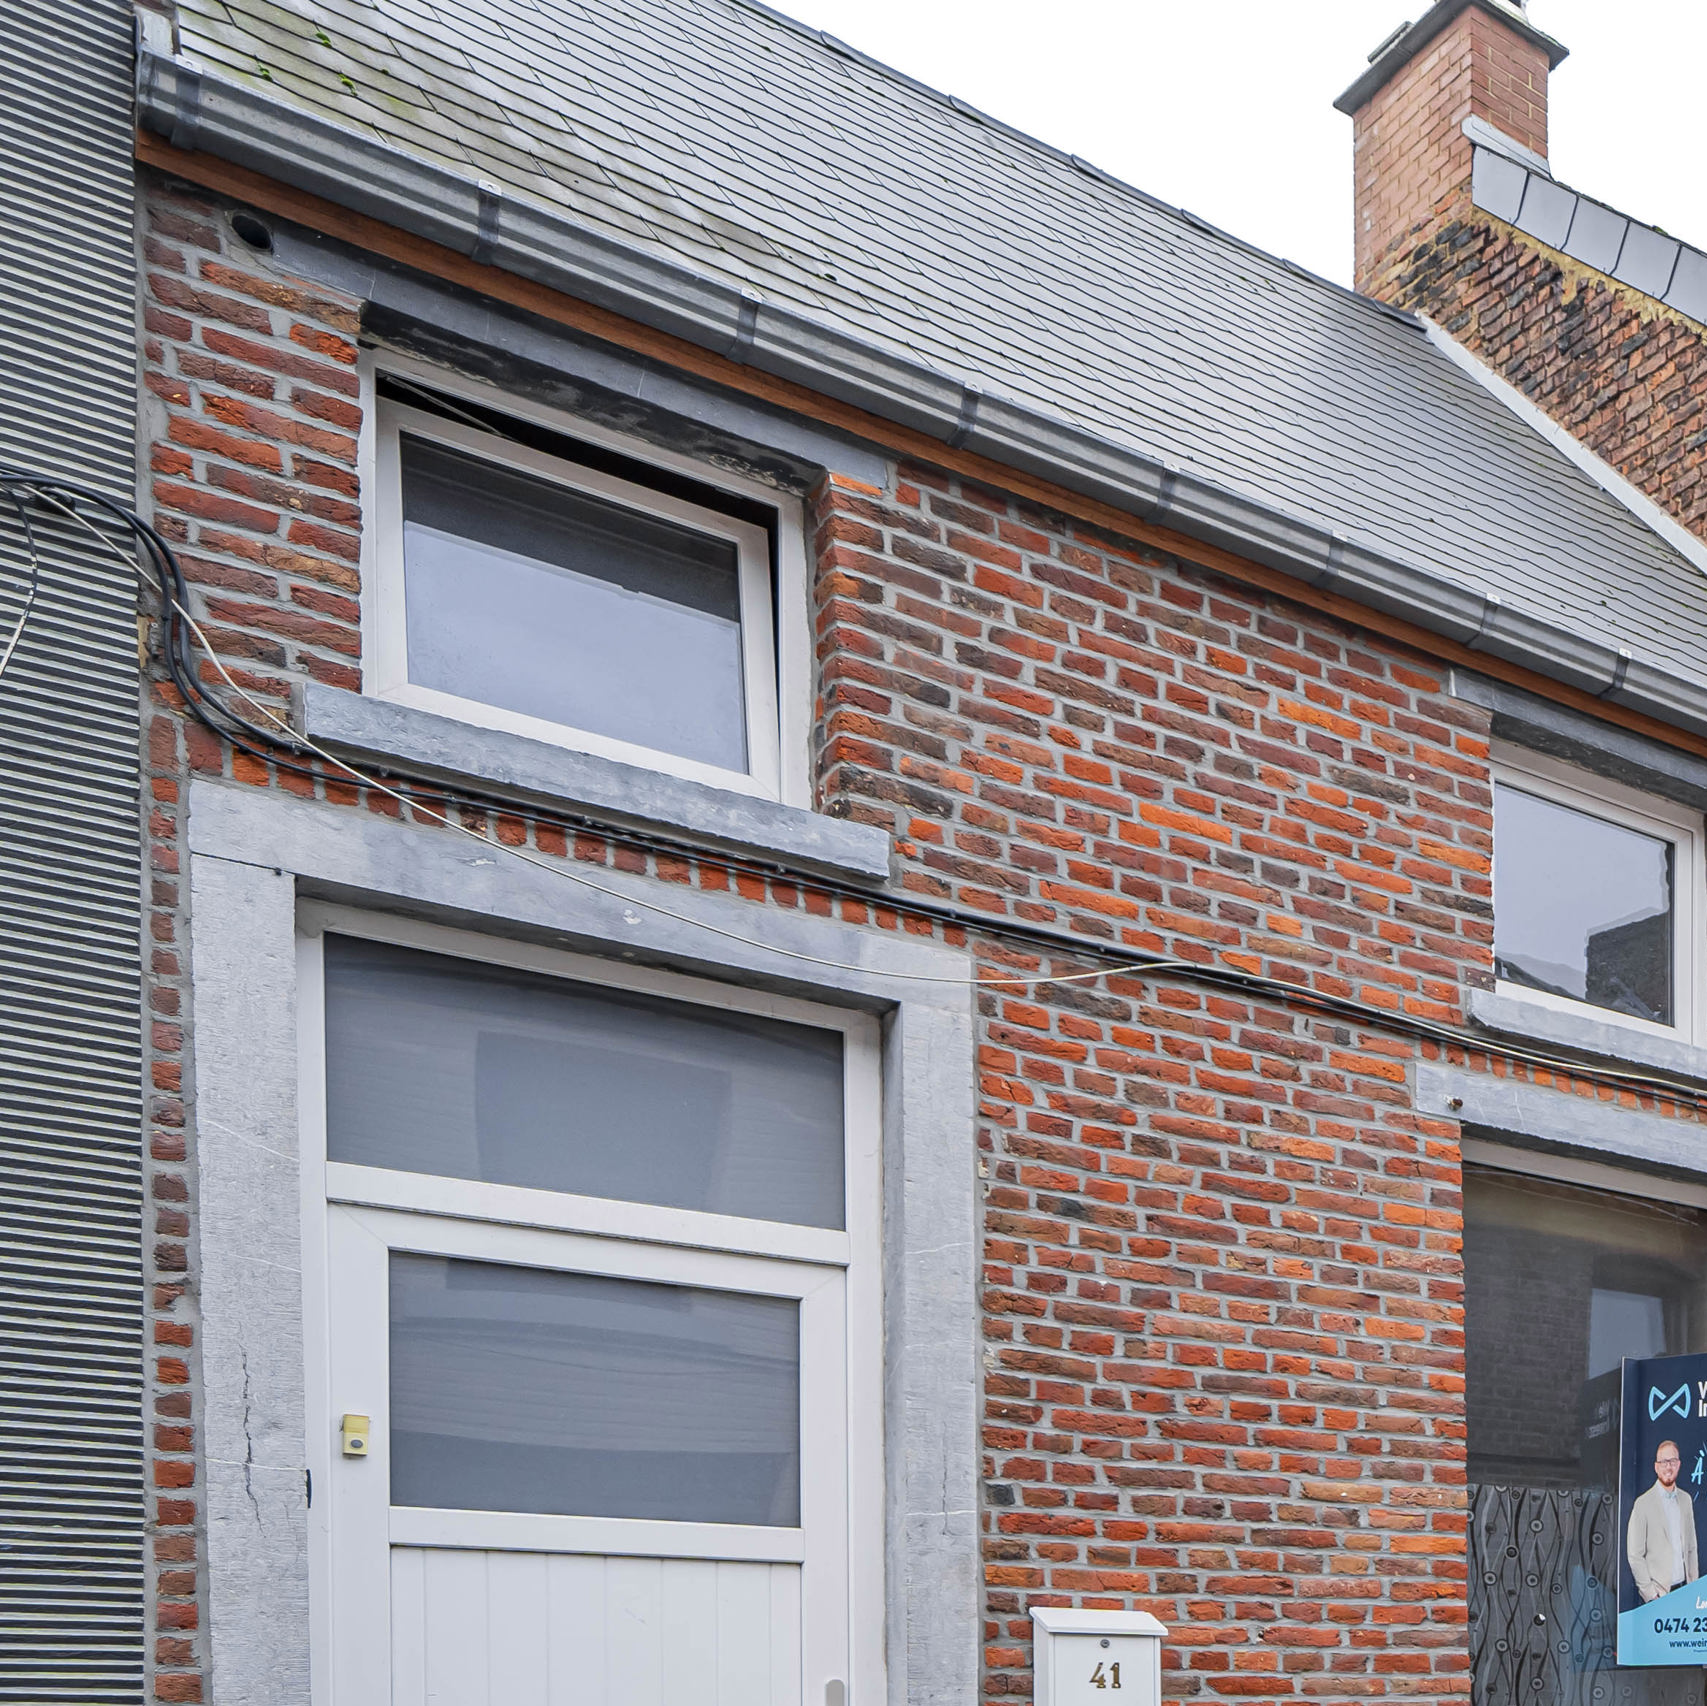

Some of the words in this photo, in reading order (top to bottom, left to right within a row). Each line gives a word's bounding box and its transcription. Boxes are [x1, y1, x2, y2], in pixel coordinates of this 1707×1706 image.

[1691, 1449, 1705, 1485] À
[1654, 1618, 1690, 1633] 0474
[1089, 1661, 1121, 1689] 41
